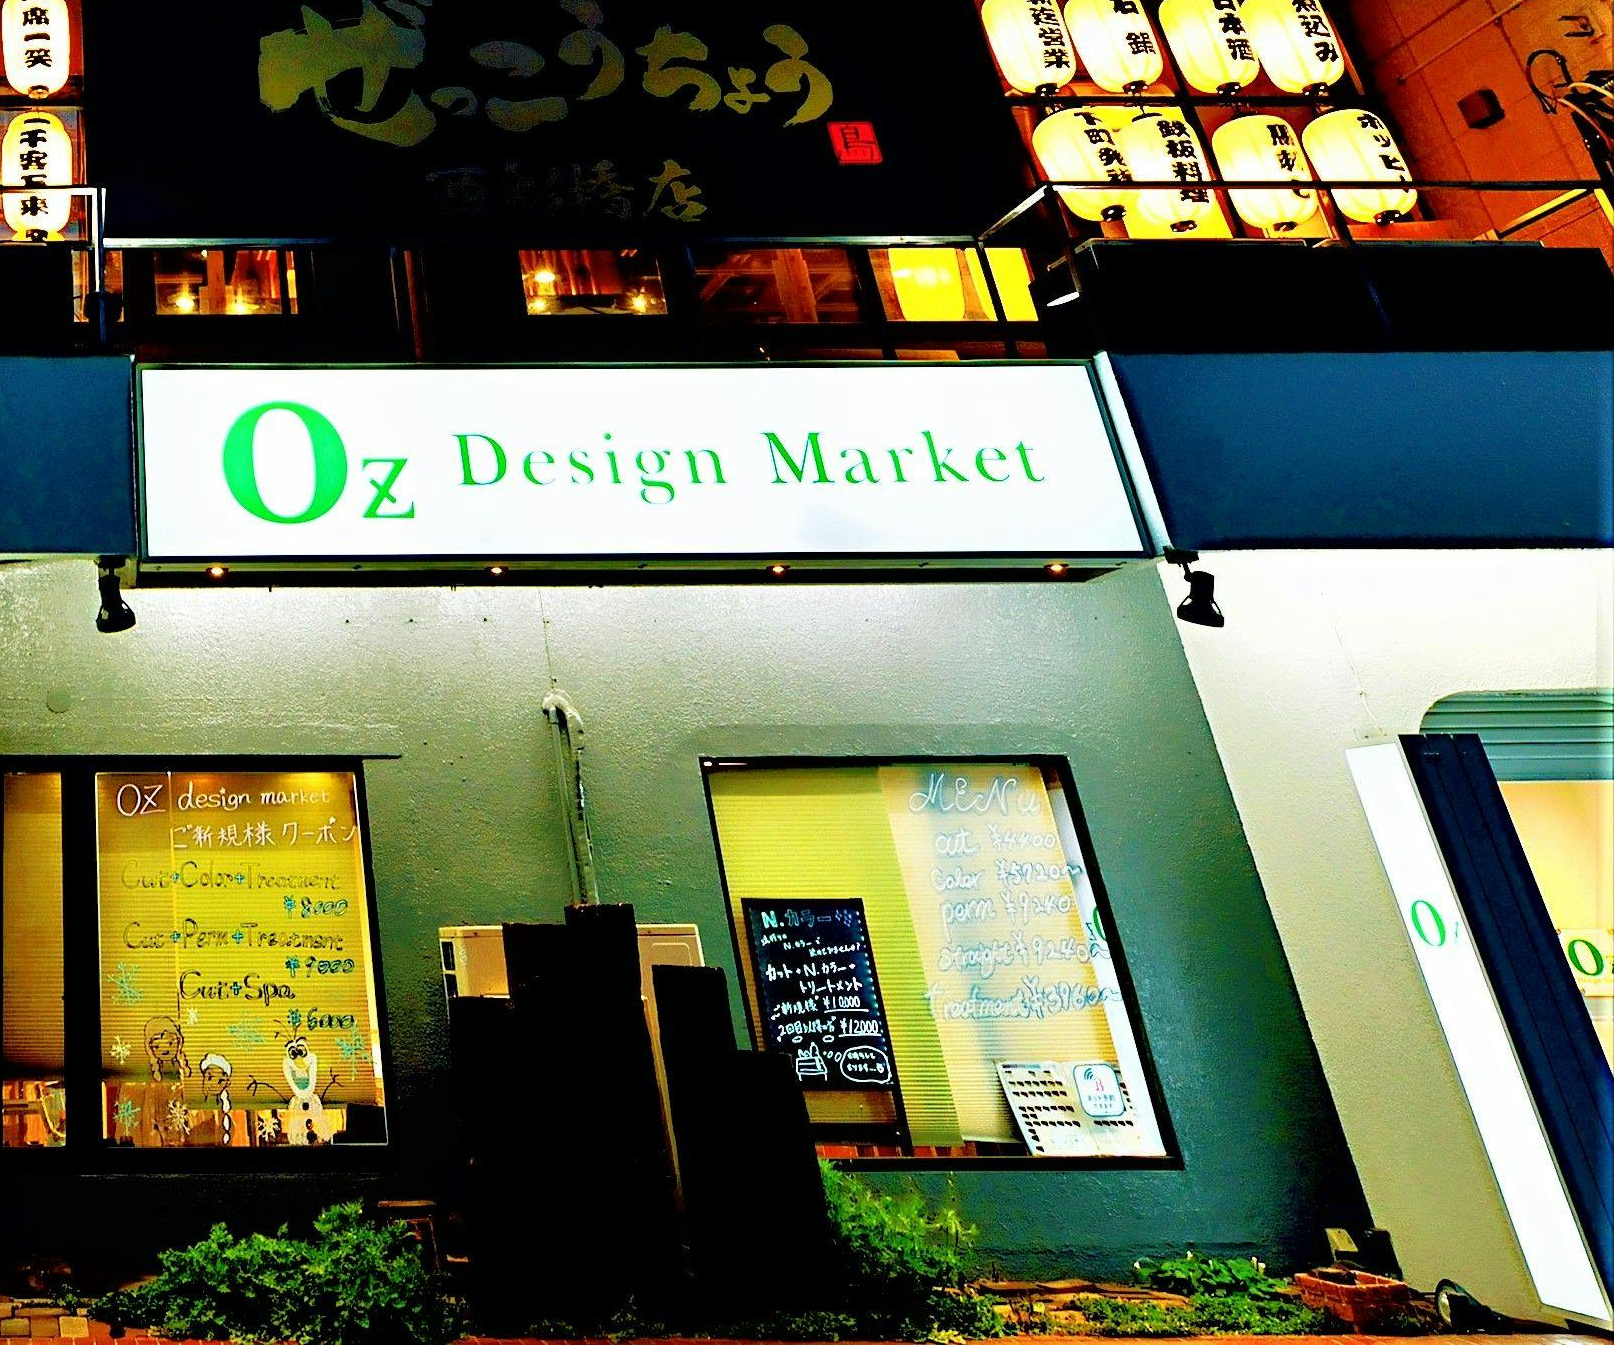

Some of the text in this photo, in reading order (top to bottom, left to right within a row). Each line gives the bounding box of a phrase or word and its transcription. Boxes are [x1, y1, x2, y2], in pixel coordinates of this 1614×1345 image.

[1156, 120, 1210, 203] 鉄板料理
[1266, 124, 1311, 199] 馬刺し
[222, 399, 1048, 526] Oz Design Market
[177, 780, 252, 812] design
[260, 789, 331, 805] market
[173, 815, 357, 849] ご新規様 クーポン
[760, 908, 832, 929] N.カラー
[799, 976, 863, 995] トリートメント
